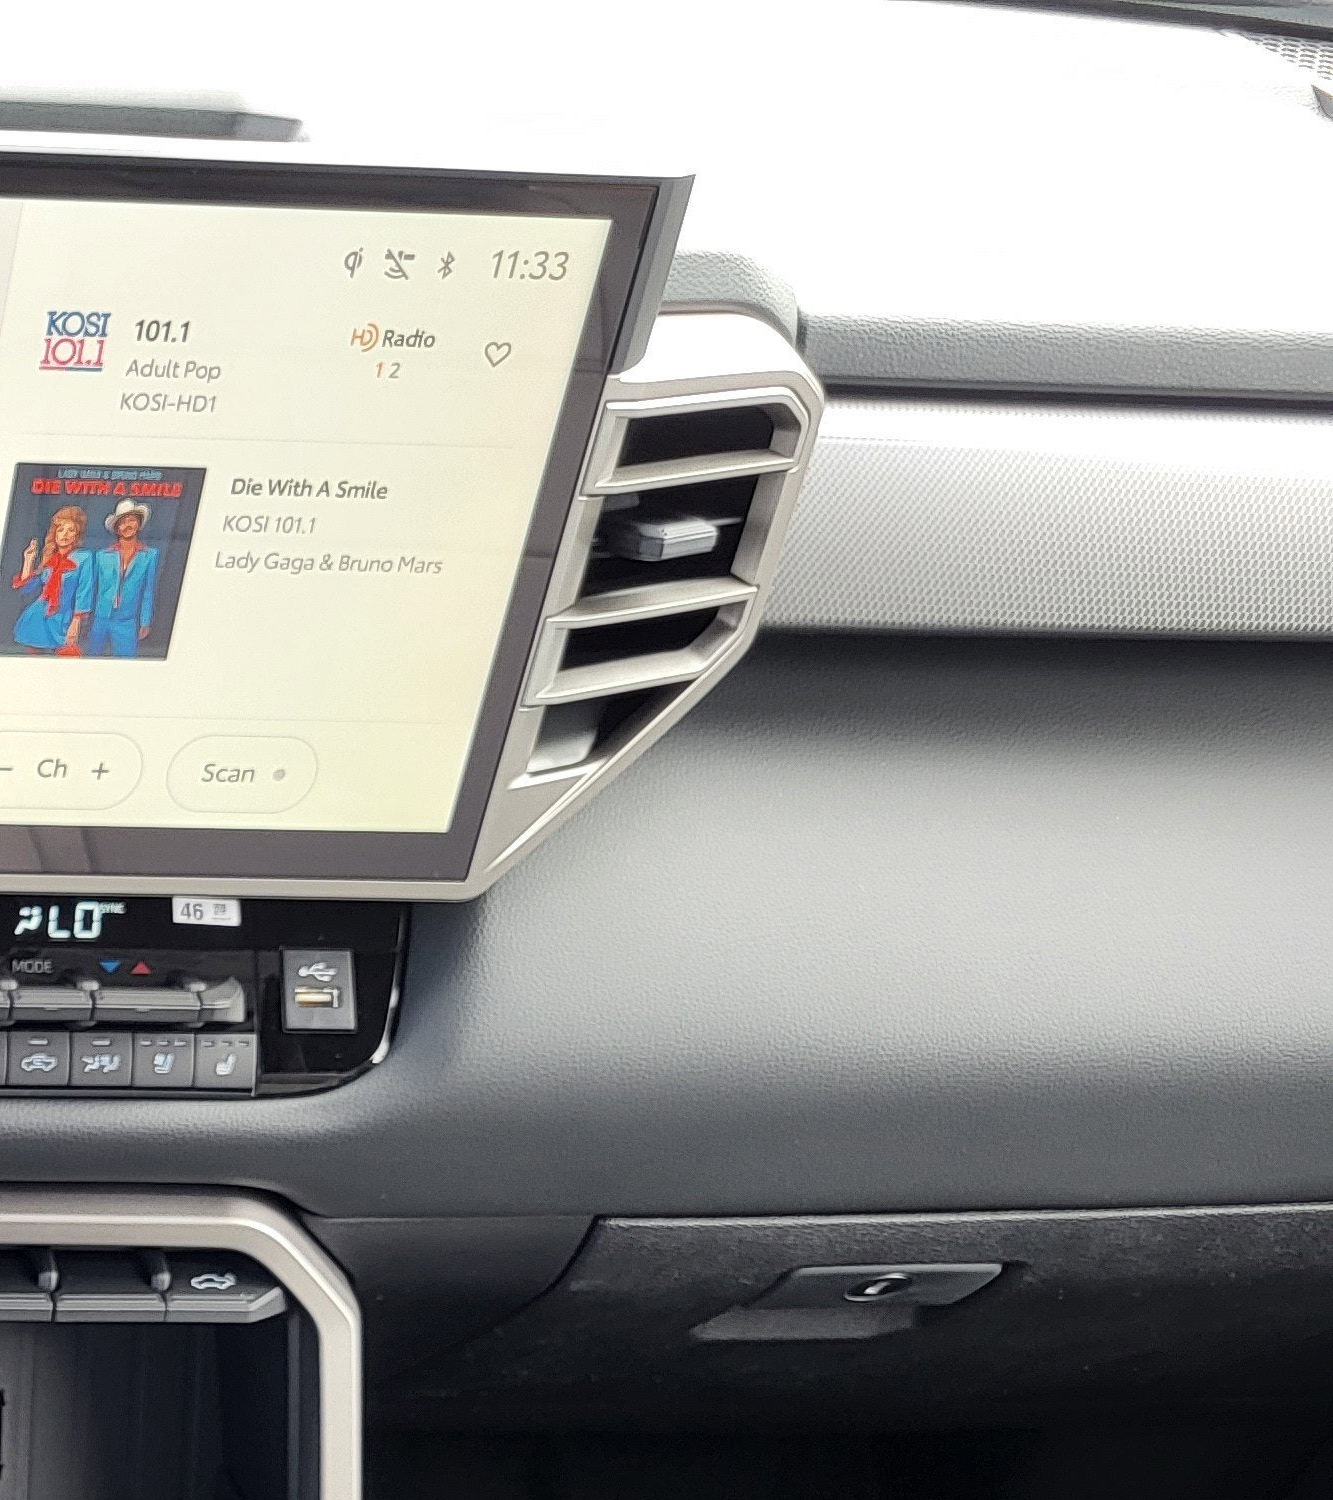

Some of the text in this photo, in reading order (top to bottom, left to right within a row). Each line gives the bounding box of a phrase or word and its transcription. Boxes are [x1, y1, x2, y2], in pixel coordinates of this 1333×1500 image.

[491, 250, 570, 281] 11:33
[46, 311, 111, 338] KOSI
[134, 320, 191, 343] 101.1
[382, 329, 436, 349] Radio
[40, 337, 105, 368] 101.1
[125, 359, 222, 384] Adult Pop
[375, 362, 401, 379] 1 2
[120, 392, 217, 414] KOSI-HD1
[31, 478, 183, 497] DIE WITH A SMILE
[231, 478, 389, 500] Die With A Smile
[222, 515, 316, 536] KOSI 101.1
[215, 552, 444, 576] Lady Gaga & Bruno Mars
[36, 758, 68, 780] Ch
[201, 763, 255, 784] Scan
[48, 901, 101, 940] LO
[180, 902, 204, 921] 46
[11, 959, 53, 974] MODE
